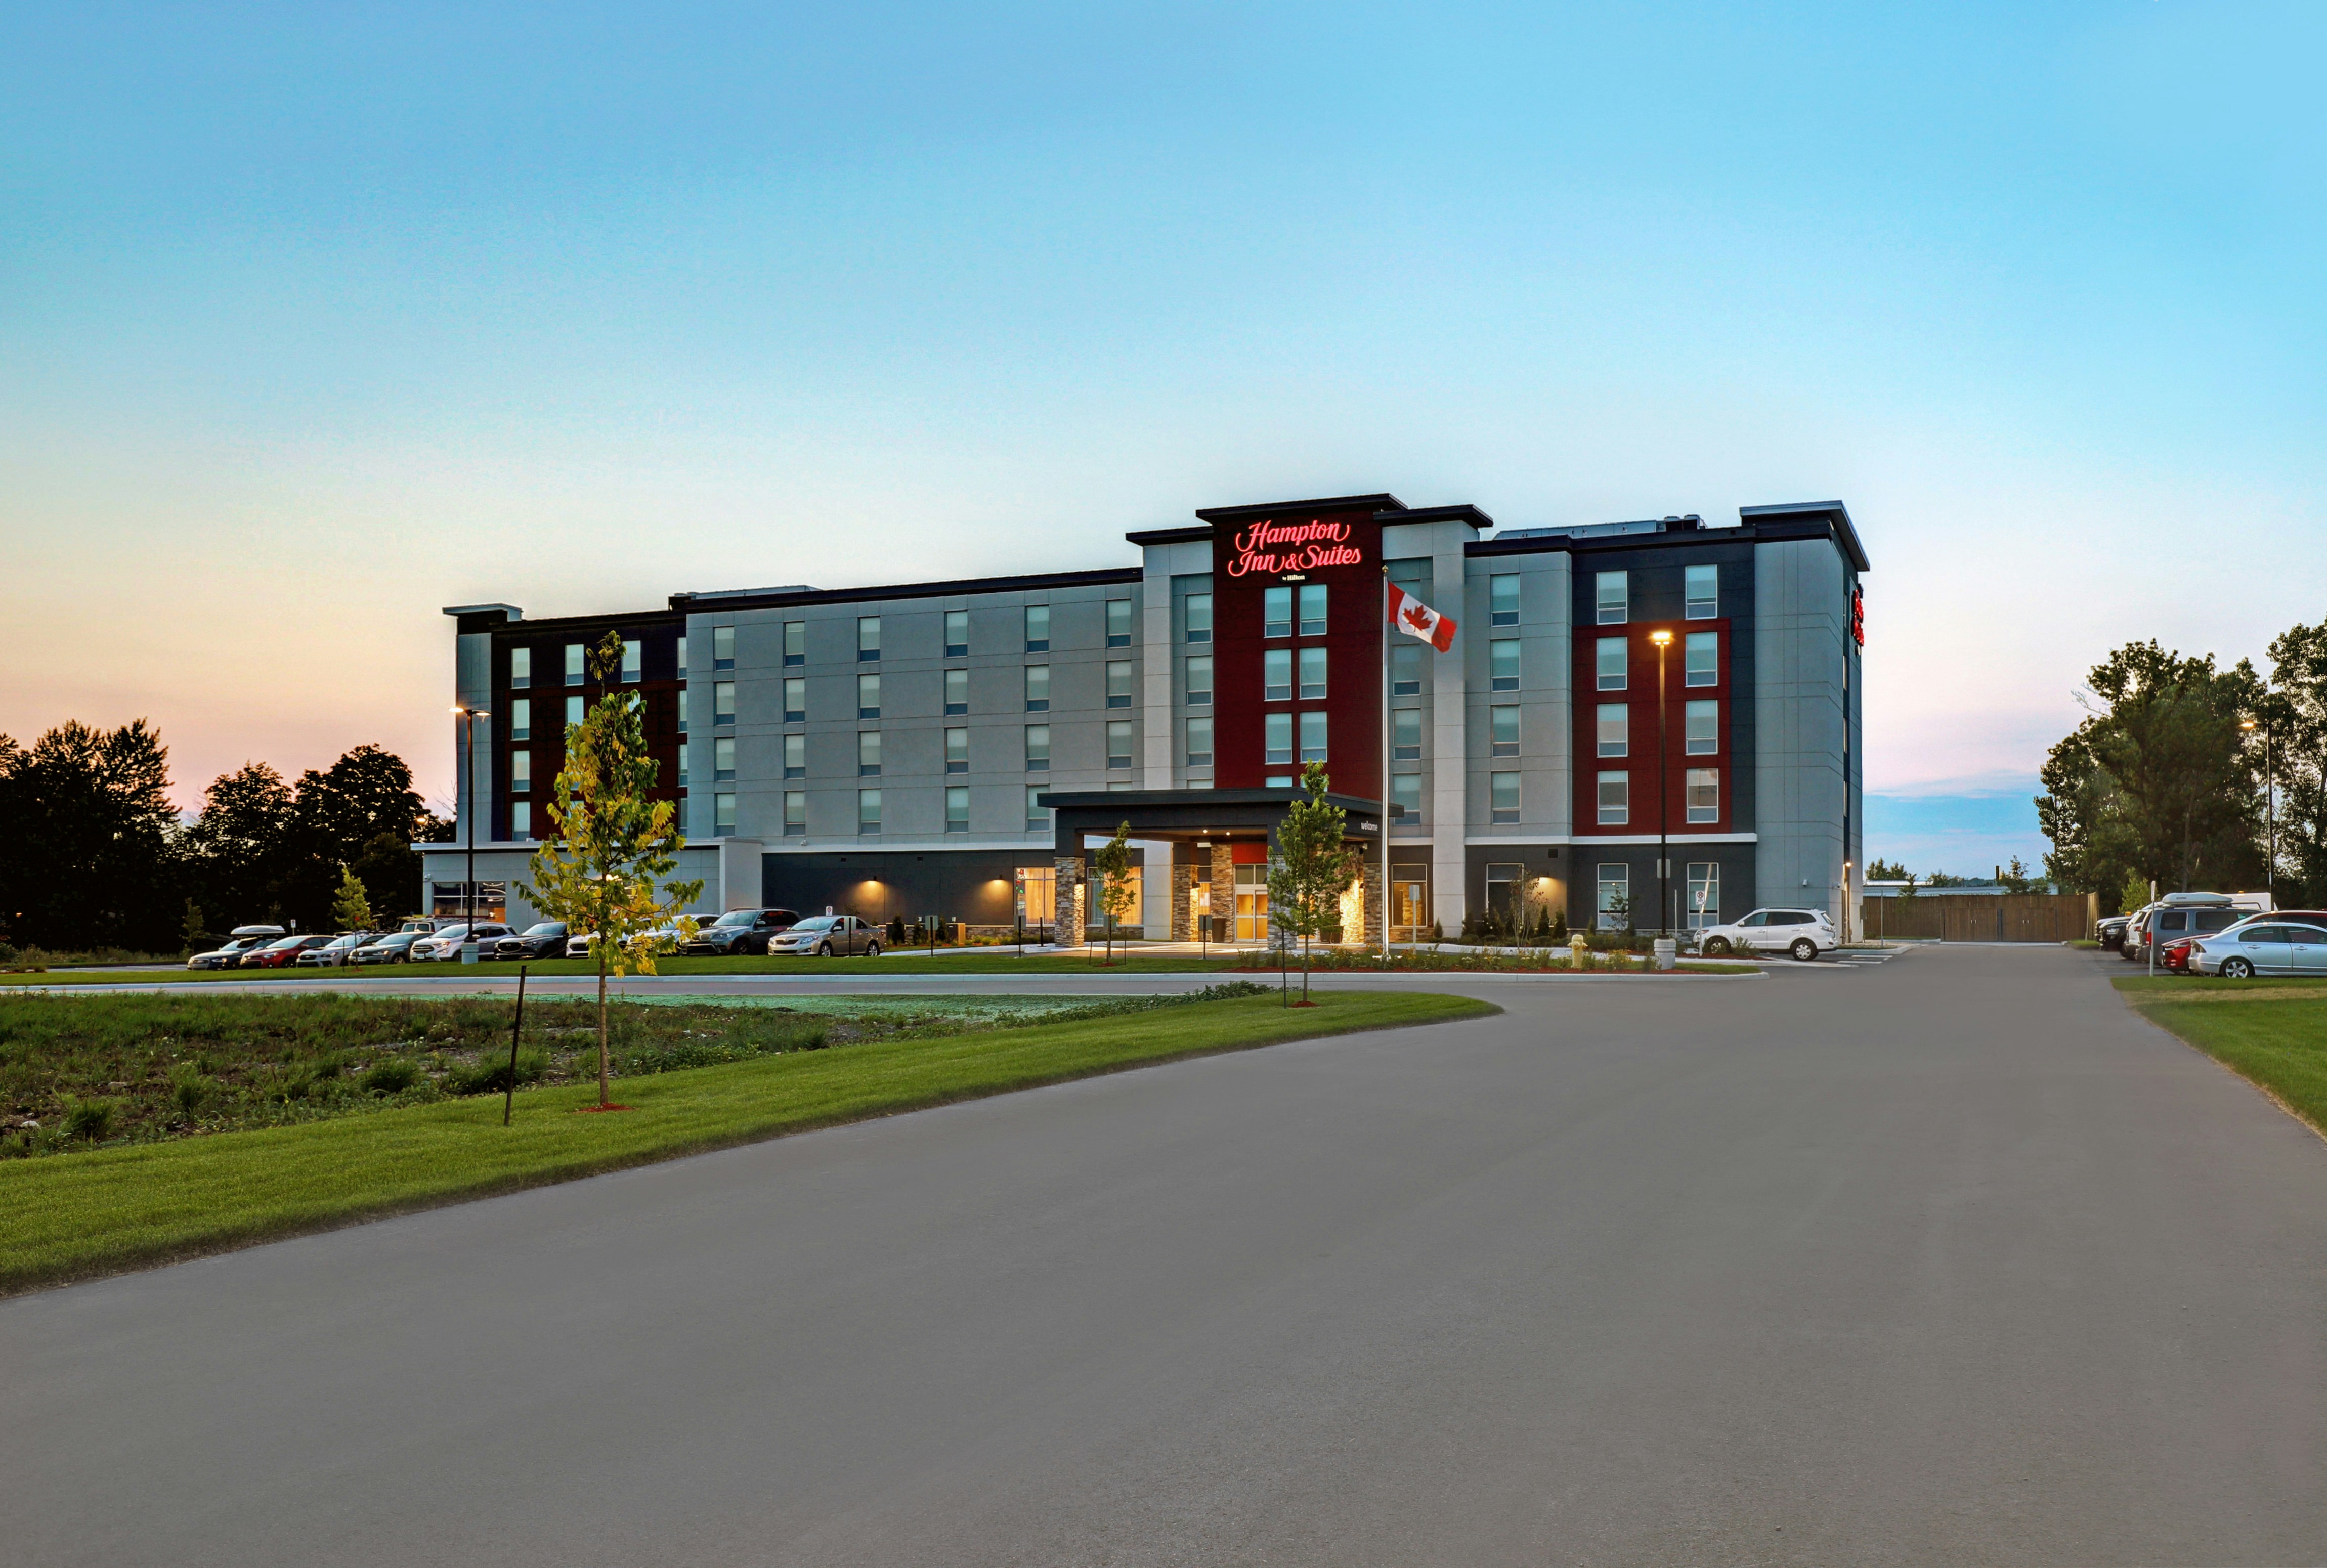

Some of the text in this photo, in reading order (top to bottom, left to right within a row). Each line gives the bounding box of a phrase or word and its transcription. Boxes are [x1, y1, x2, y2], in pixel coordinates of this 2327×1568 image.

[1235, 520, 1350, 552] Hampton
[1228, 545, 1362, 576] Inn & Suites
[1361, 820, 1378, 831] welcome
